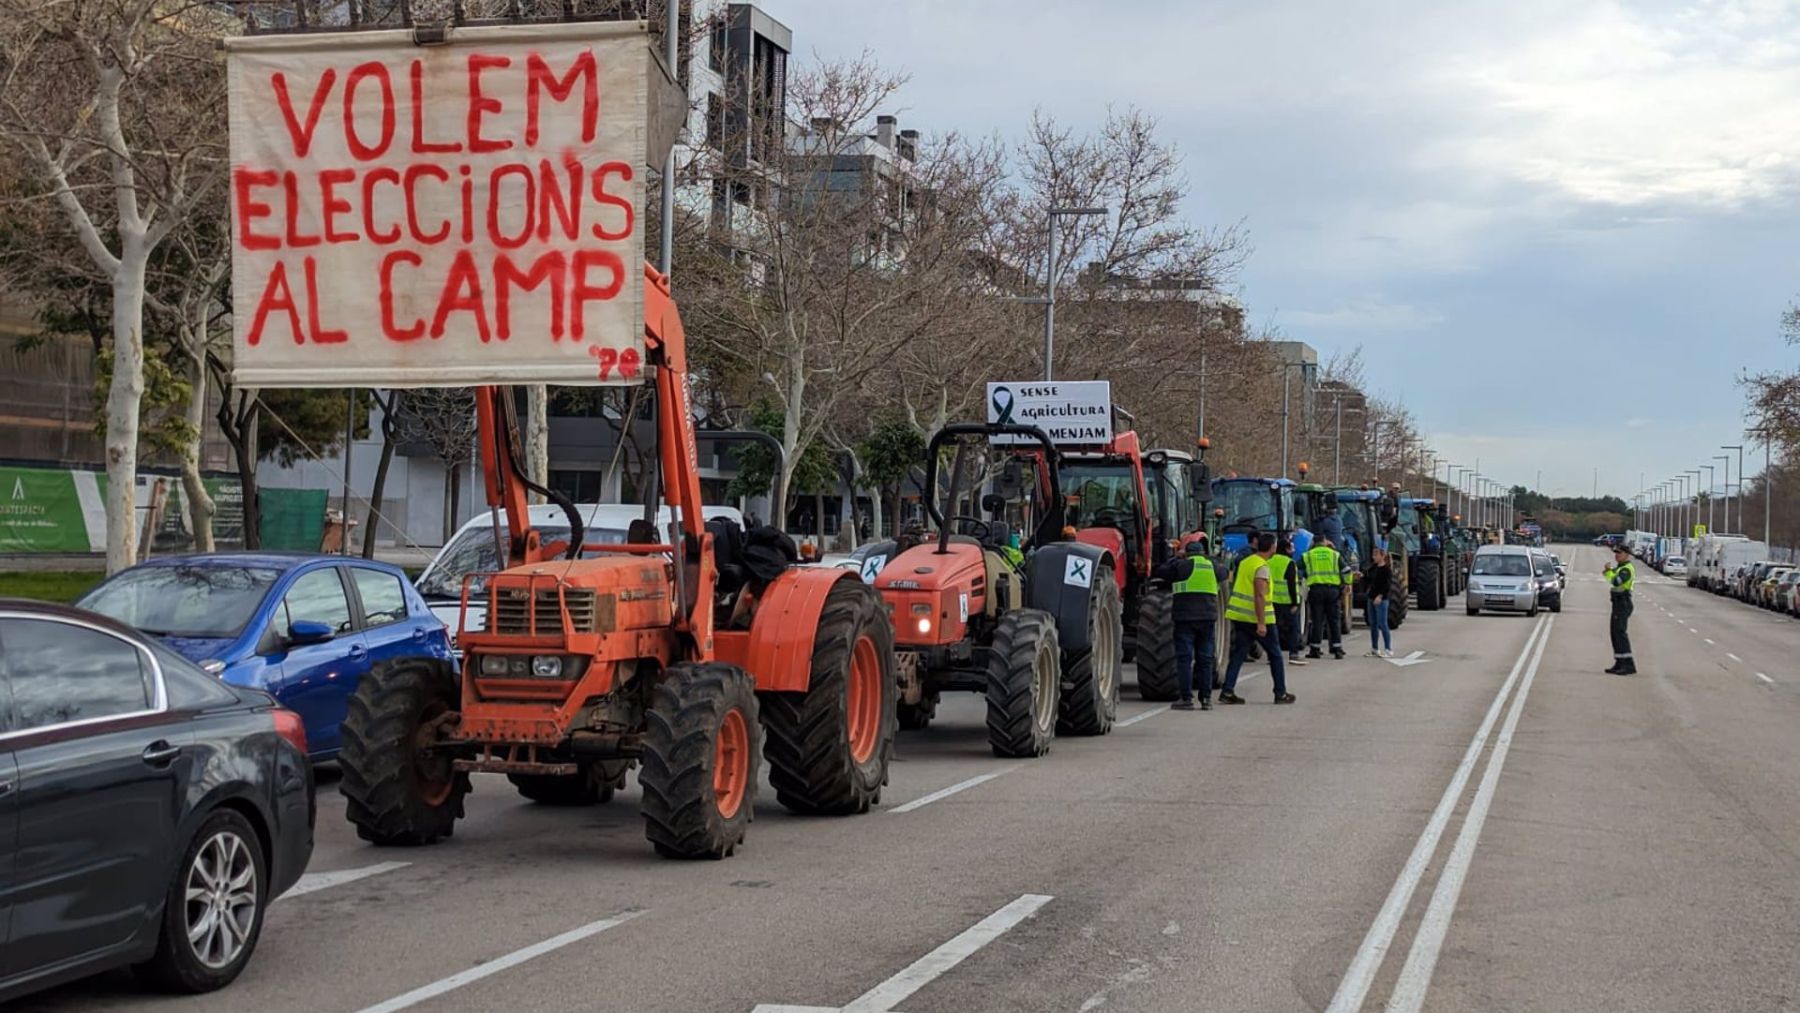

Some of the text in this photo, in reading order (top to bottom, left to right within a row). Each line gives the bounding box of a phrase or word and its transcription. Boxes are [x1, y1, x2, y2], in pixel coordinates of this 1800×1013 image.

[271, 50, 600, 162] VOLEM
[246, 248, 626, 346] AL CAMP
[1020, 386, 1058, 397] SENSE
[1049, 427, 1106, 439] MENJAM
